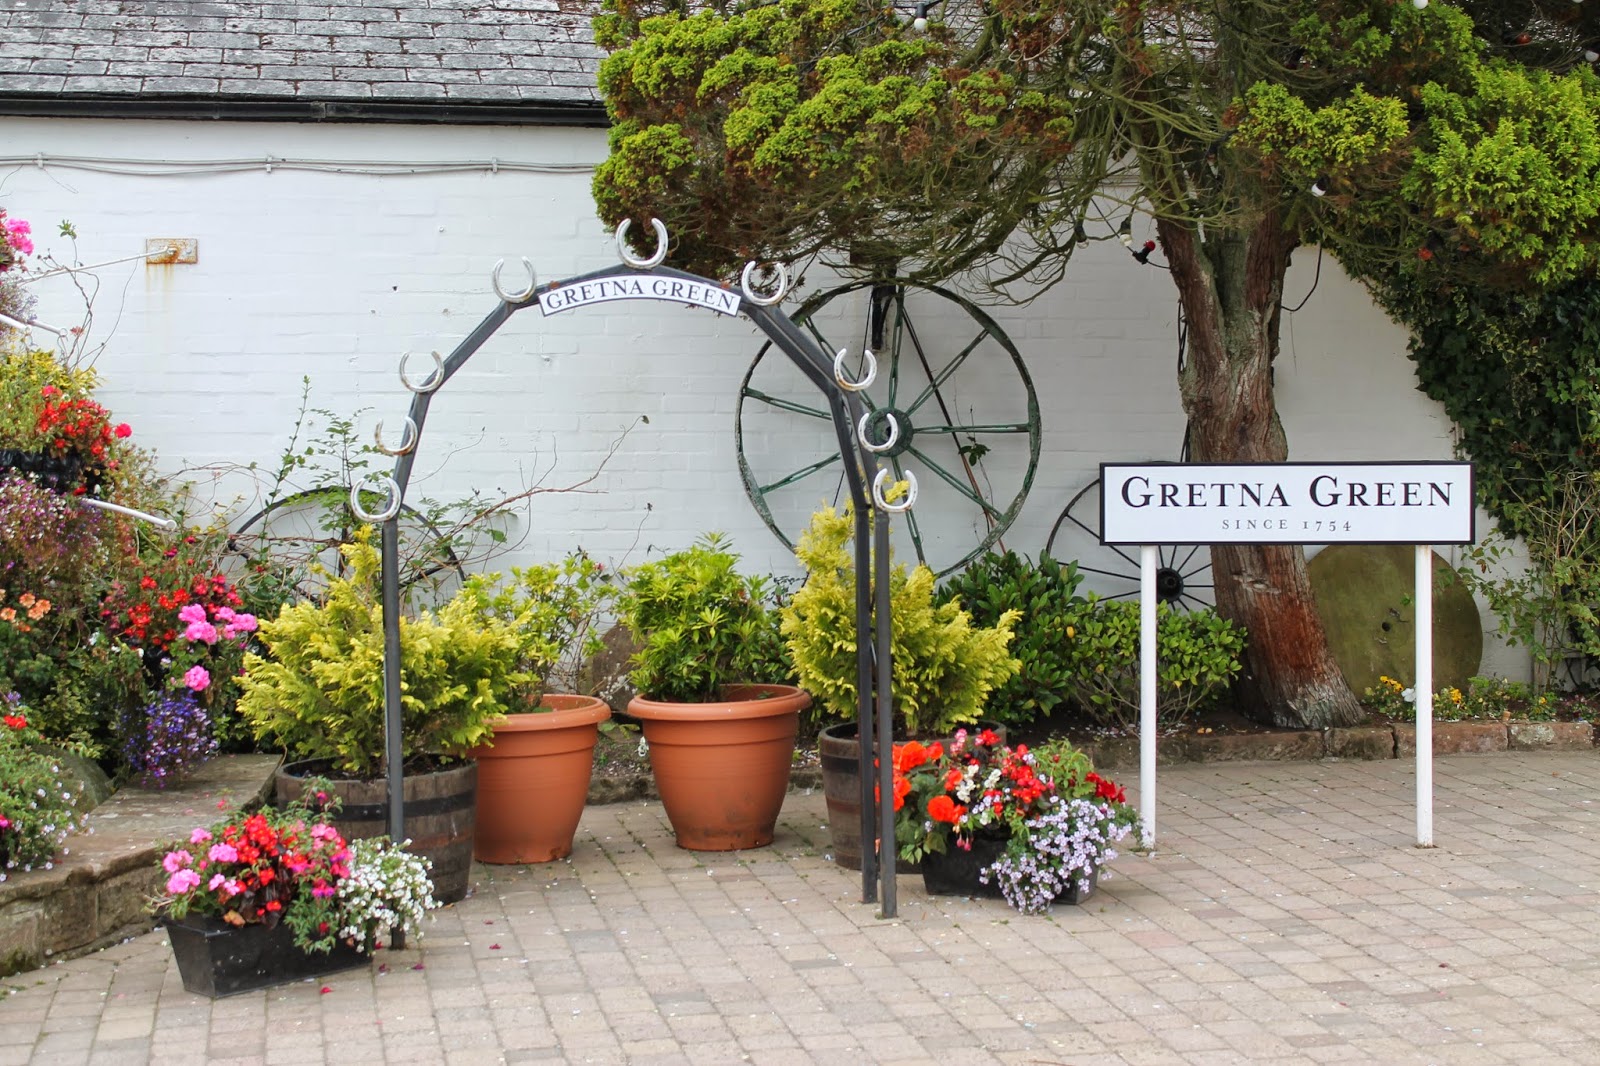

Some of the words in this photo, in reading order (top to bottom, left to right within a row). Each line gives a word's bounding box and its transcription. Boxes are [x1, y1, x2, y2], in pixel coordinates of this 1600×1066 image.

[547, 279, 645, 309] GRETNA
[653, 279, 734, 310] GREEN
[1121, 475, 1291, 508] GRETNA
[1309, 475, 1453, 507] GREEN
[1222, 519, 1288, 530] SINCE
[1303, 520, 1352, 532] 1754
